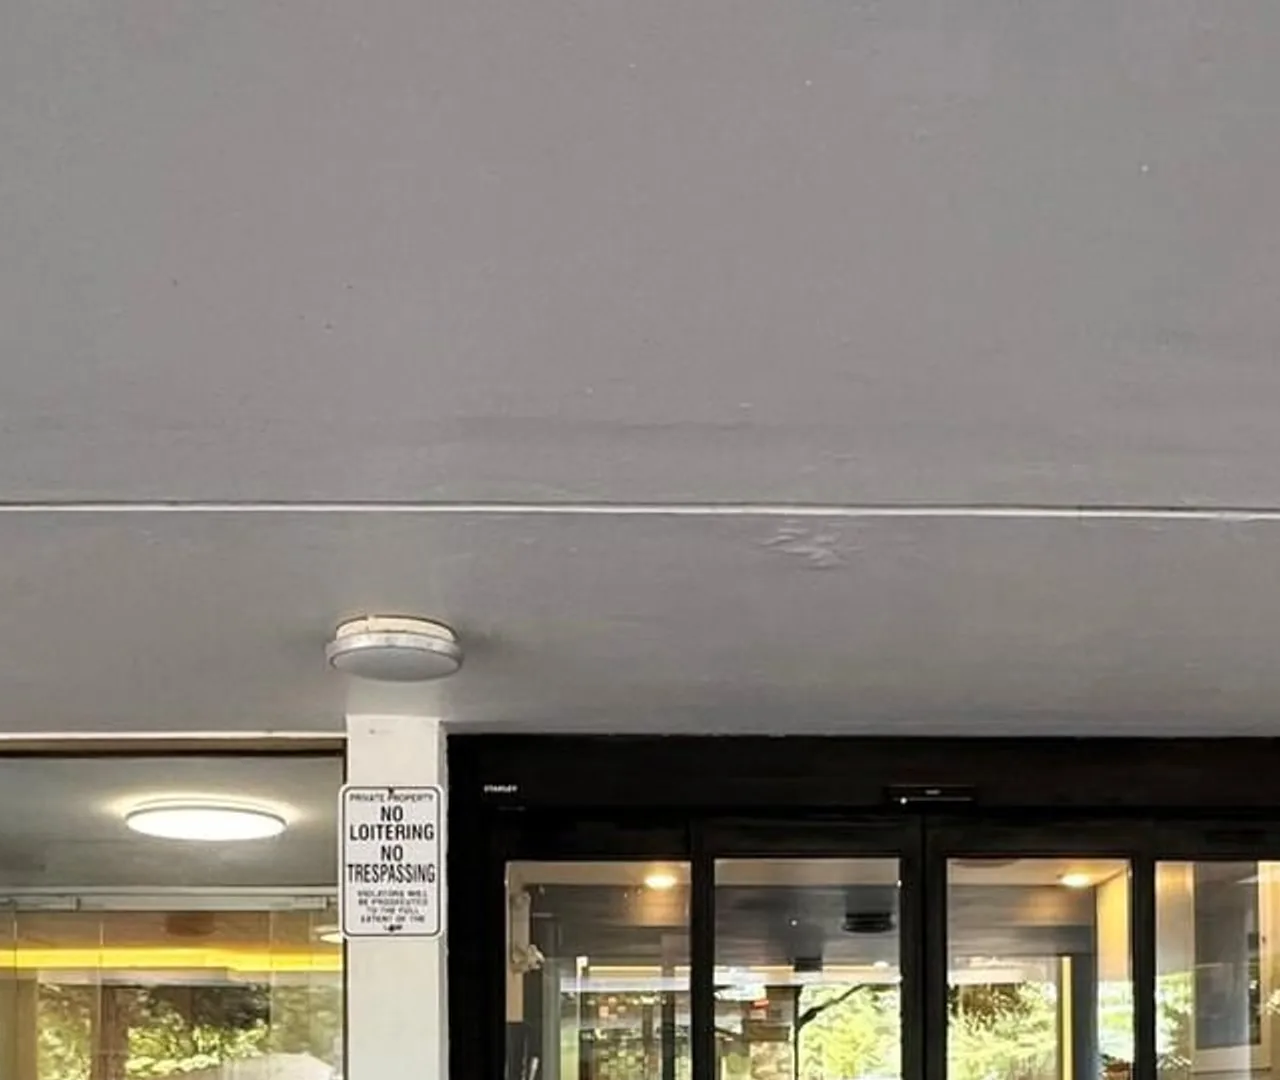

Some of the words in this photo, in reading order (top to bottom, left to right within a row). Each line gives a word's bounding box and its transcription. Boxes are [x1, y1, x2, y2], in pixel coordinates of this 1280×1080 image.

[380, 805, 403, 822] NO
[350, 824, 434, 841] LOITERING
[380, 844, 403, 861] NO
[348, 864, 435, 883] TRESPASSING
